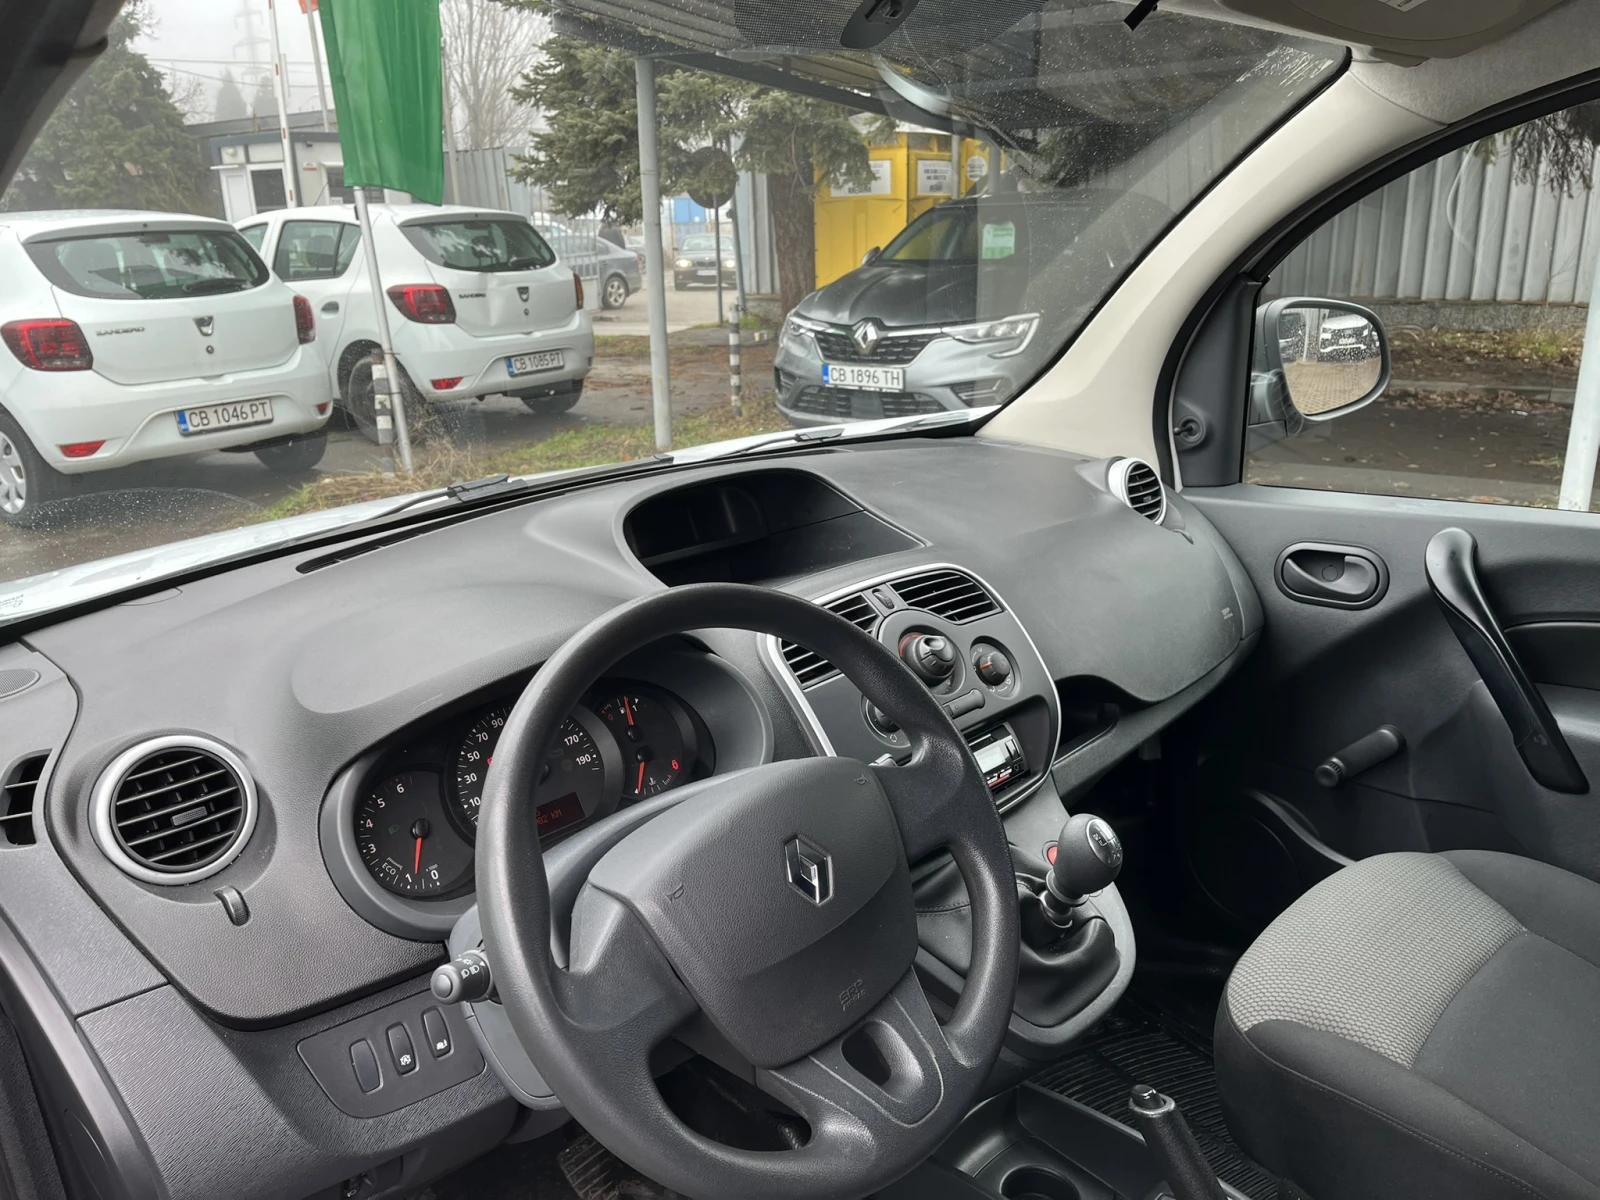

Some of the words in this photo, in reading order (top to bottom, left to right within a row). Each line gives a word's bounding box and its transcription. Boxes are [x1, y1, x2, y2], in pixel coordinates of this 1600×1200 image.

[513, 358, 527, 371] CB
[550, 351, 562, 366] PT
[830, 367, 847, 382] CB
[850, 368, 880, 384] 1896
[882, 370, 901, 386] TH
[188, 411, 211, 429] CB
[213, 405, 249, 425] 1046
[248, 401, 268, 421] PT
[491, 716, 504, 729] 90
[475, 732, 489, 743] 70
[563, 734, 580, 746] 170
[466, 750, 480, 762] 50
[575, 753, 592, 766] 190
[464, 772, 478, 784] 30
[396, 783, 405, 794] 6
[377, 797, 386, 809] 5
[469, 796, 482, 808] 10
[365, 818, 374, 829] 4
[536, 815, 549, 825] 82
[367, 843, 377, 854] 3
[381, 862, 397, 876] ECO
[430, 869, 439, 880] 0
[405, 873, 412, 883] 1
